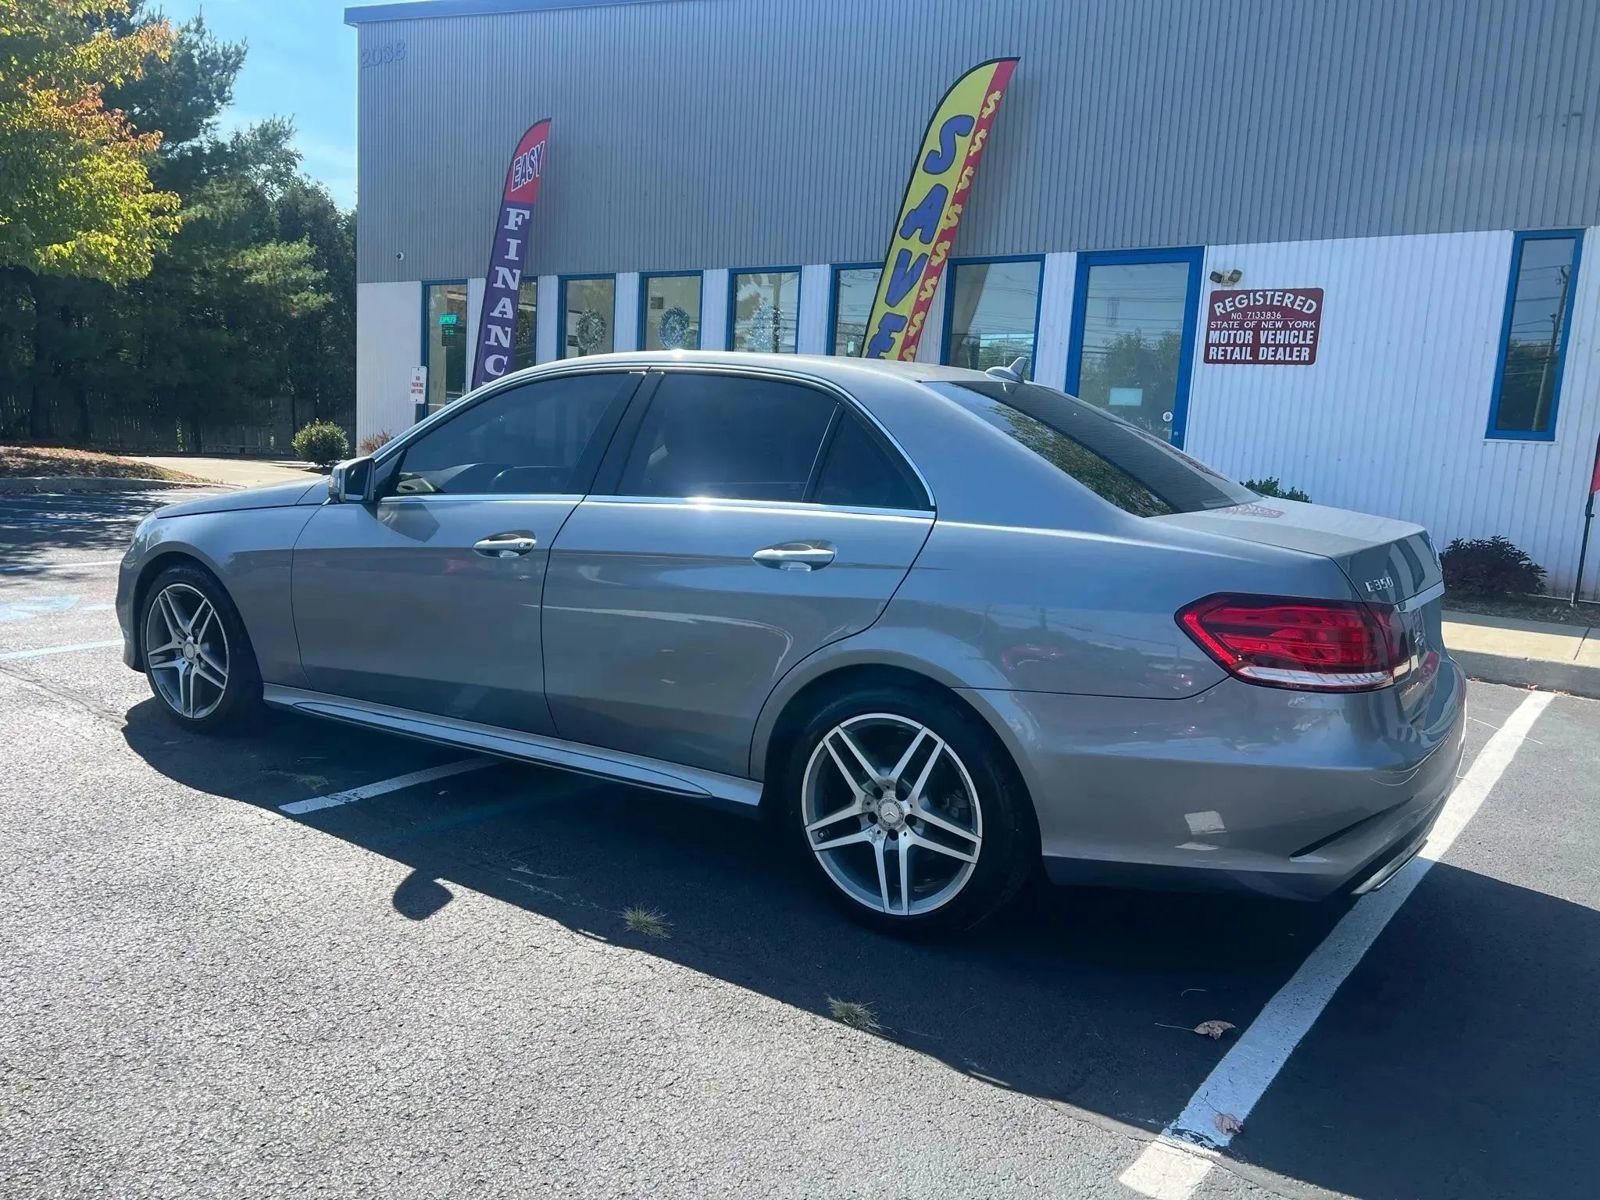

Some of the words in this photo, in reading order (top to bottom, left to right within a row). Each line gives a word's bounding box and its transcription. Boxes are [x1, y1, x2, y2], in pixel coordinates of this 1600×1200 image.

[511, 140, 546, 193] EASY
[866, 114, 976, 359] SAVE
[482, 207, 530, 386] FINANC
[1213, 291, 1317, 316] REGISTERED
[1210, 321, 1240, 329] STATE
[1244, 320, 1258, 329] OF
[1261, 320, 1284, 329] NEW
[1287, 320, 1316, 329] YORK
[1208, 330, 1254, 344] MOTOR
[1259, 330, 1315, 345] VEHICLE
[1208, 346, 1253, 360] RETAIL
[1258, 346, 1310, 361] DEALER
